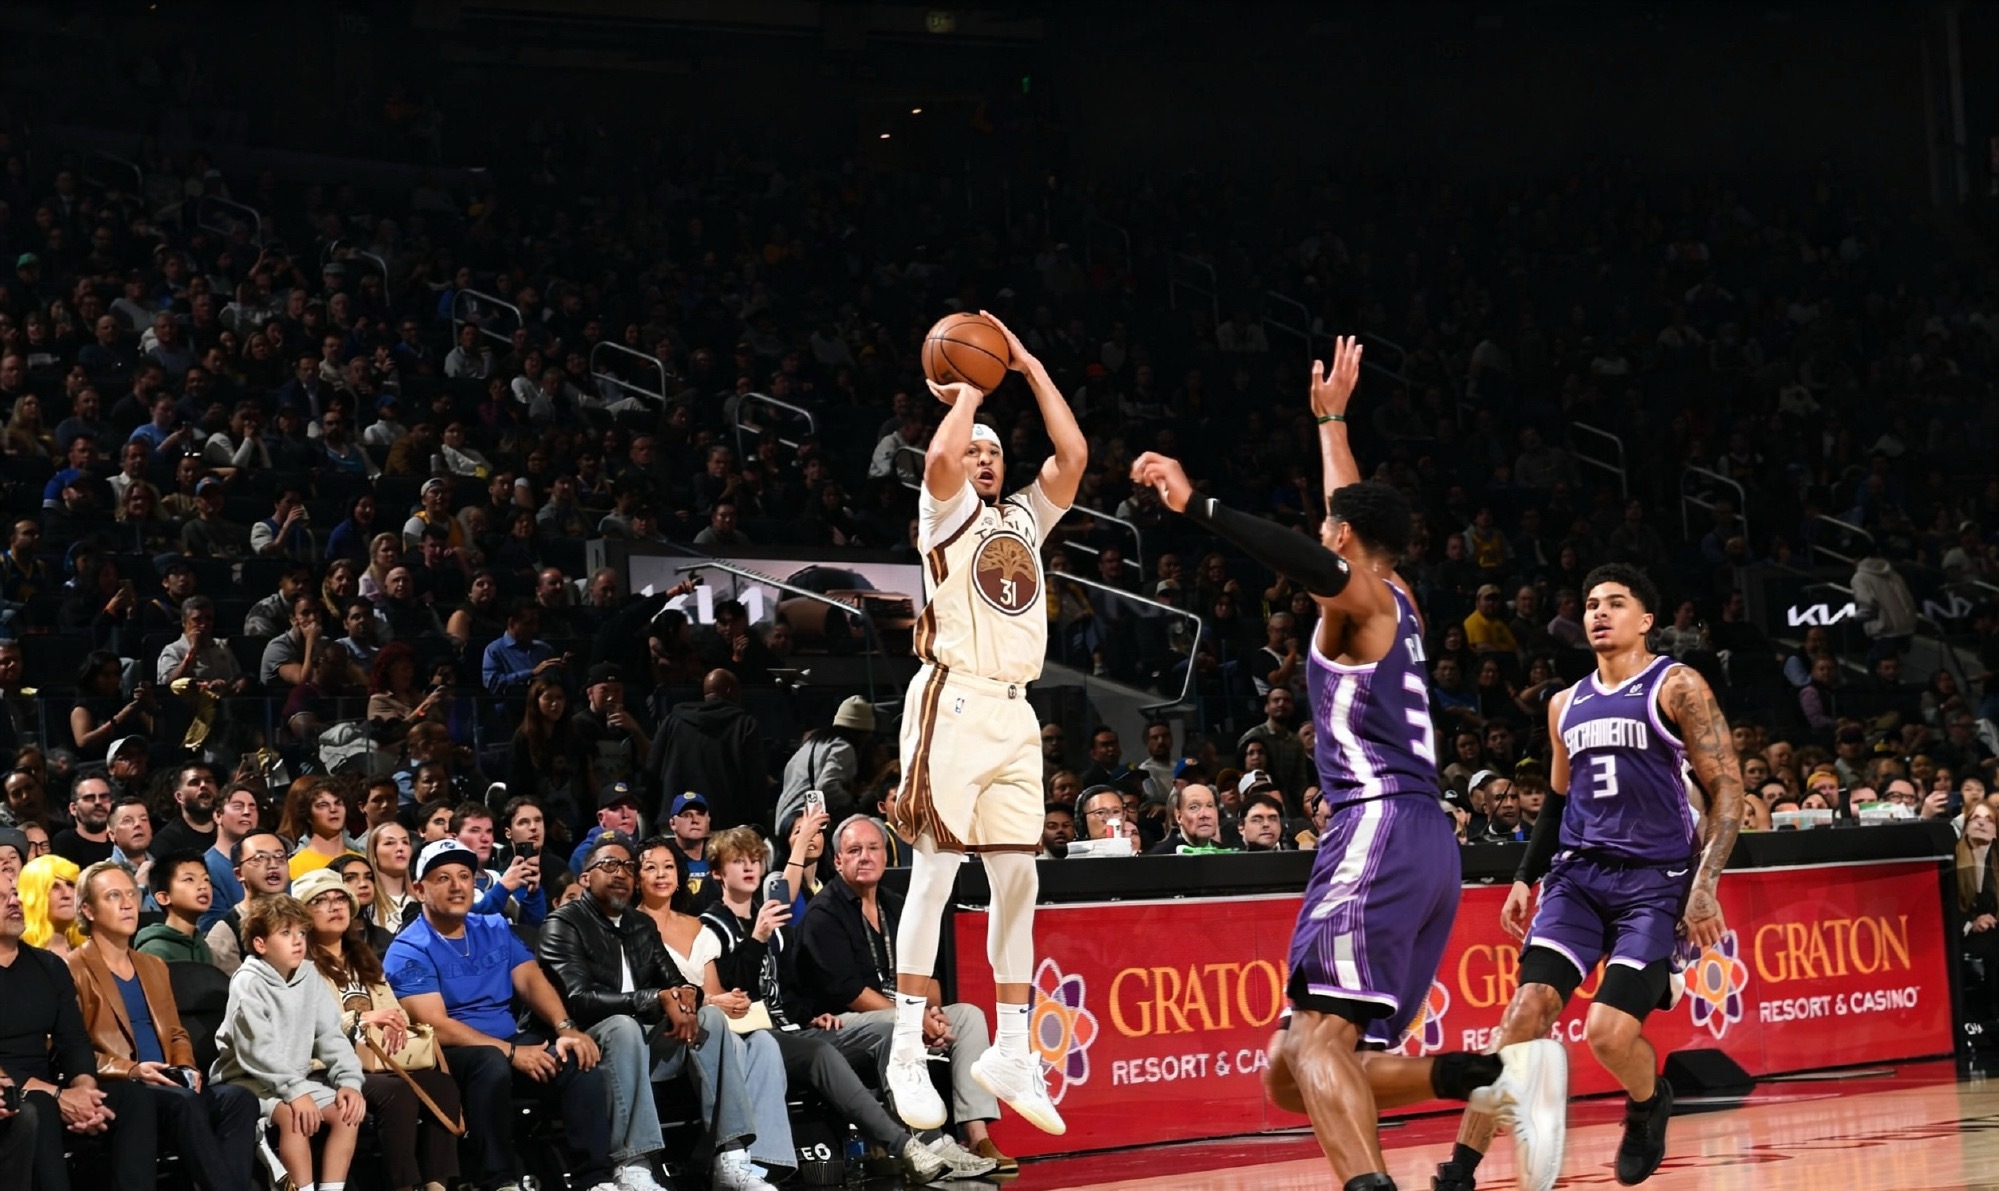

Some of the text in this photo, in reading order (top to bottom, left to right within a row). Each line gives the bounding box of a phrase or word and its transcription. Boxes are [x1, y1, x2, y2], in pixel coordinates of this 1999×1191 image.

[1000, 578, 1017, 608] 31
[1590, 754, 1619, 799] 3
[1754, 915, 1911, 983] GRATON
[1109, 959, 1289, 1038] GRATO
[1759, 991, 1831, 1023] RESORT
[1836, 994, 1847, 1015] &
[1112, 1054, 1210, 1086] RESORT
[1216, 1051, 1230, 1077] &
